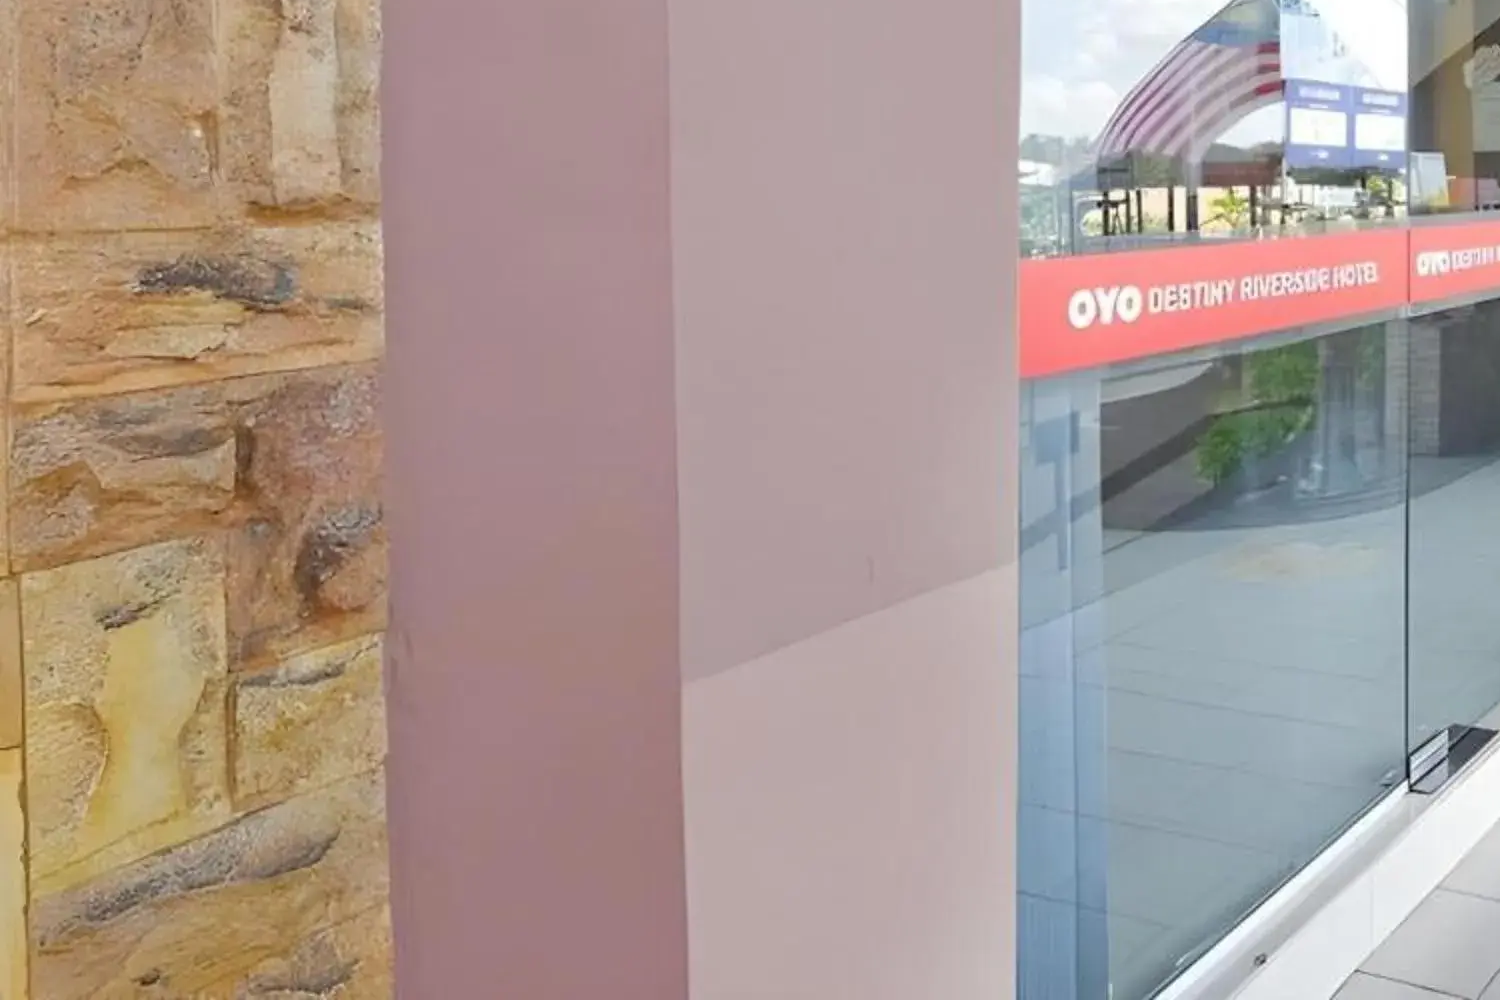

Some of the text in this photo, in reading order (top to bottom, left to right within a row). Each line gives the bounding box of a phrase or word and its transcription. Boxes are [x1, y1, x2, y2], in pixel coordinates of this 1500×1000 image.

[1068, 260, 1379, 329] OYO DESTINY RIVERSIDE HOTEL
